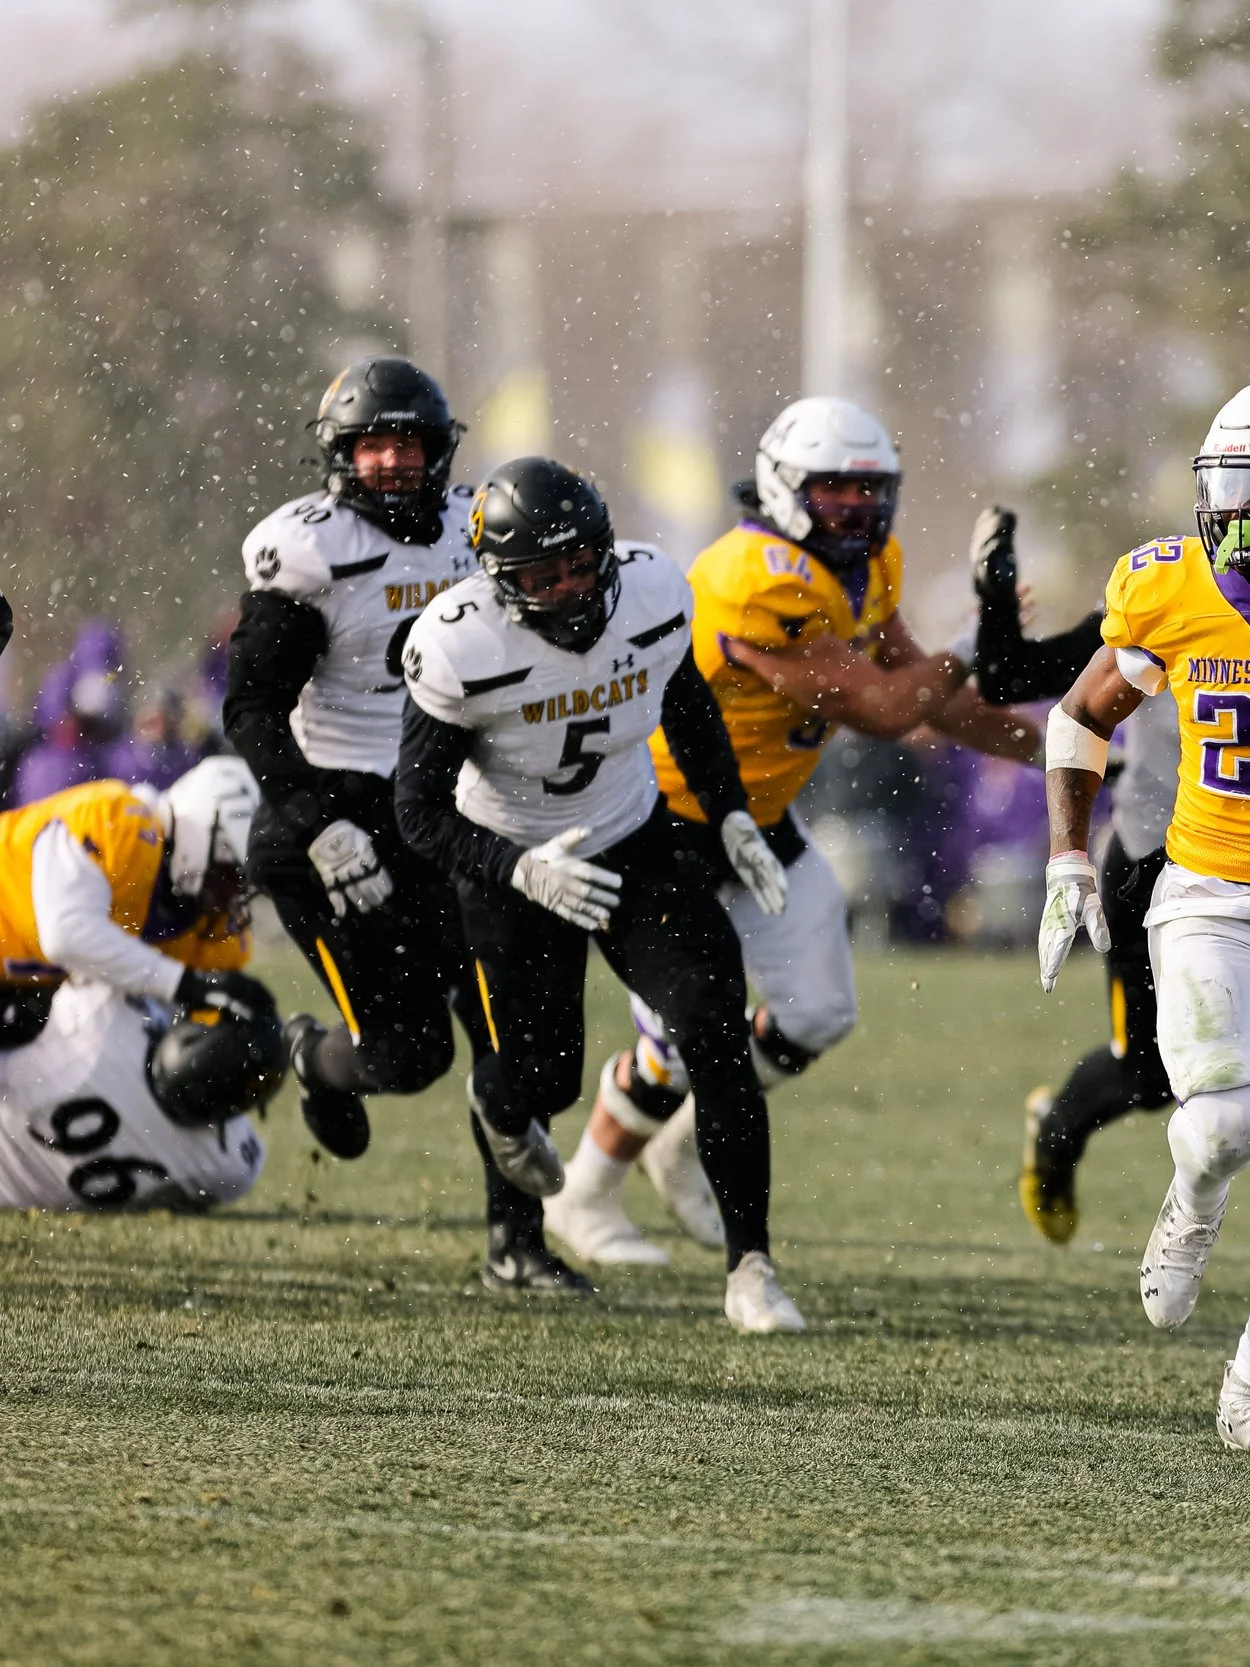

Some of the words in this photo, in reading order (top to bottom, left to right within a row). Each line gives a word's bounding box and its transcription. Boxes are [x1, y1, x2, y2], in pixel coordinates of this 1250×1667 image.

[440, 601, 479, 623] 5
[521, 668, 649, 724] WILDCATS
[542, 715, 611, 796] 5
[26, 1097, 171, 1206] 96
